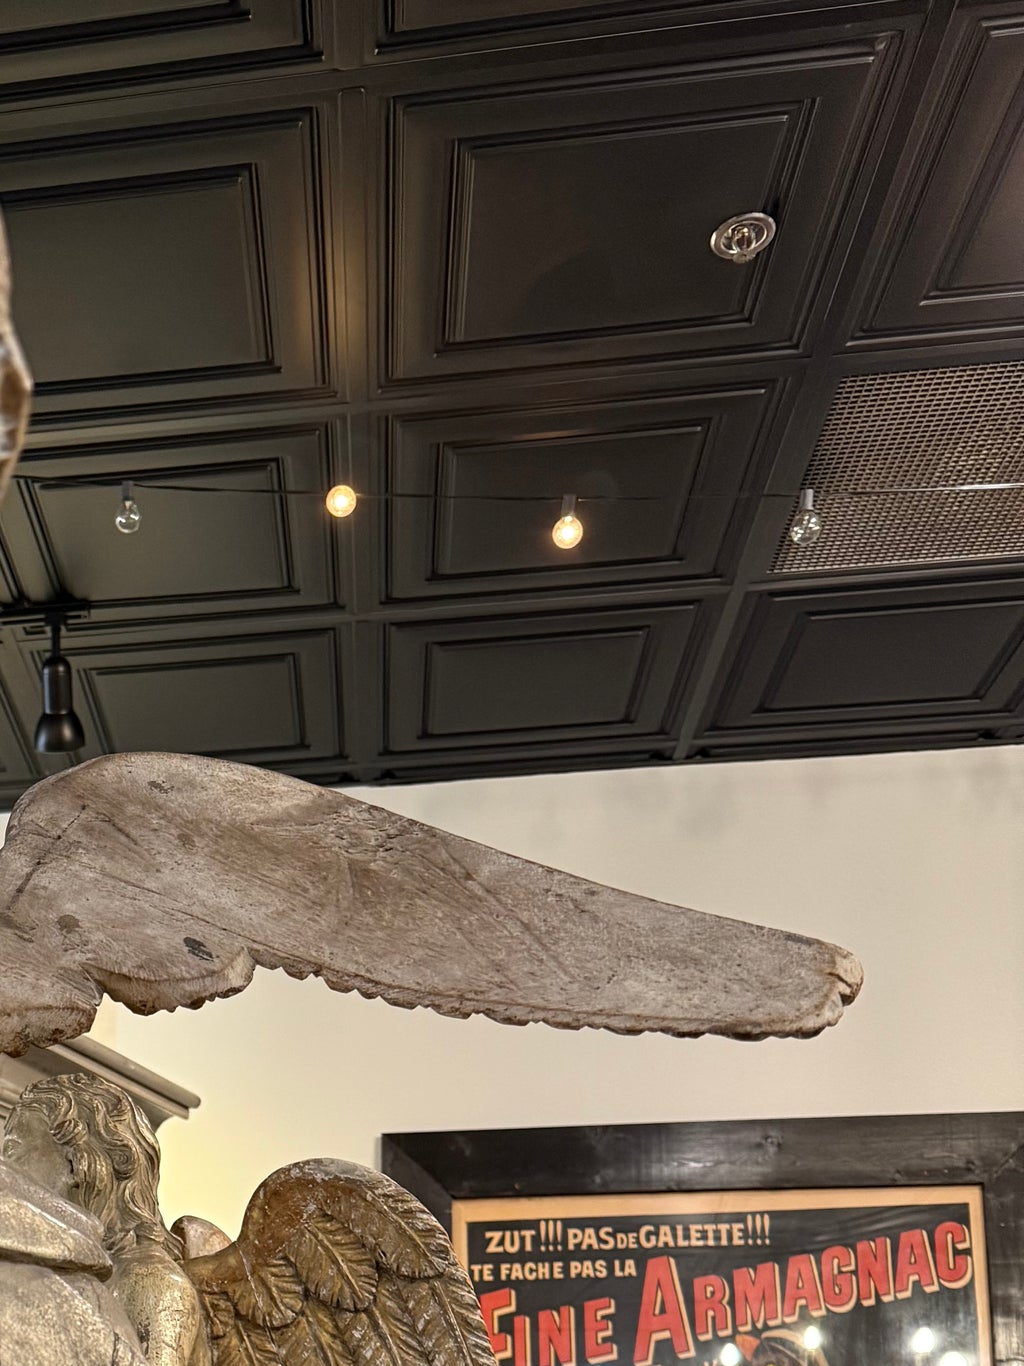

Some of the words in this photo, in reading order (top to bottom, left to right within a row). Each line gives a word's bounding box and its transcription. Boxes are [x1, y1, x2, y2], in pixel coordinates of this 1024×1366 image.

[567, 1227, 615, 1250] PAS
[471, 1264, 494, 1282] TE
[500, 1261, 564, 1281] FACHE
[570, 1260, 608, 1279] PAS
[614, 1259, 637, 1277] LA
